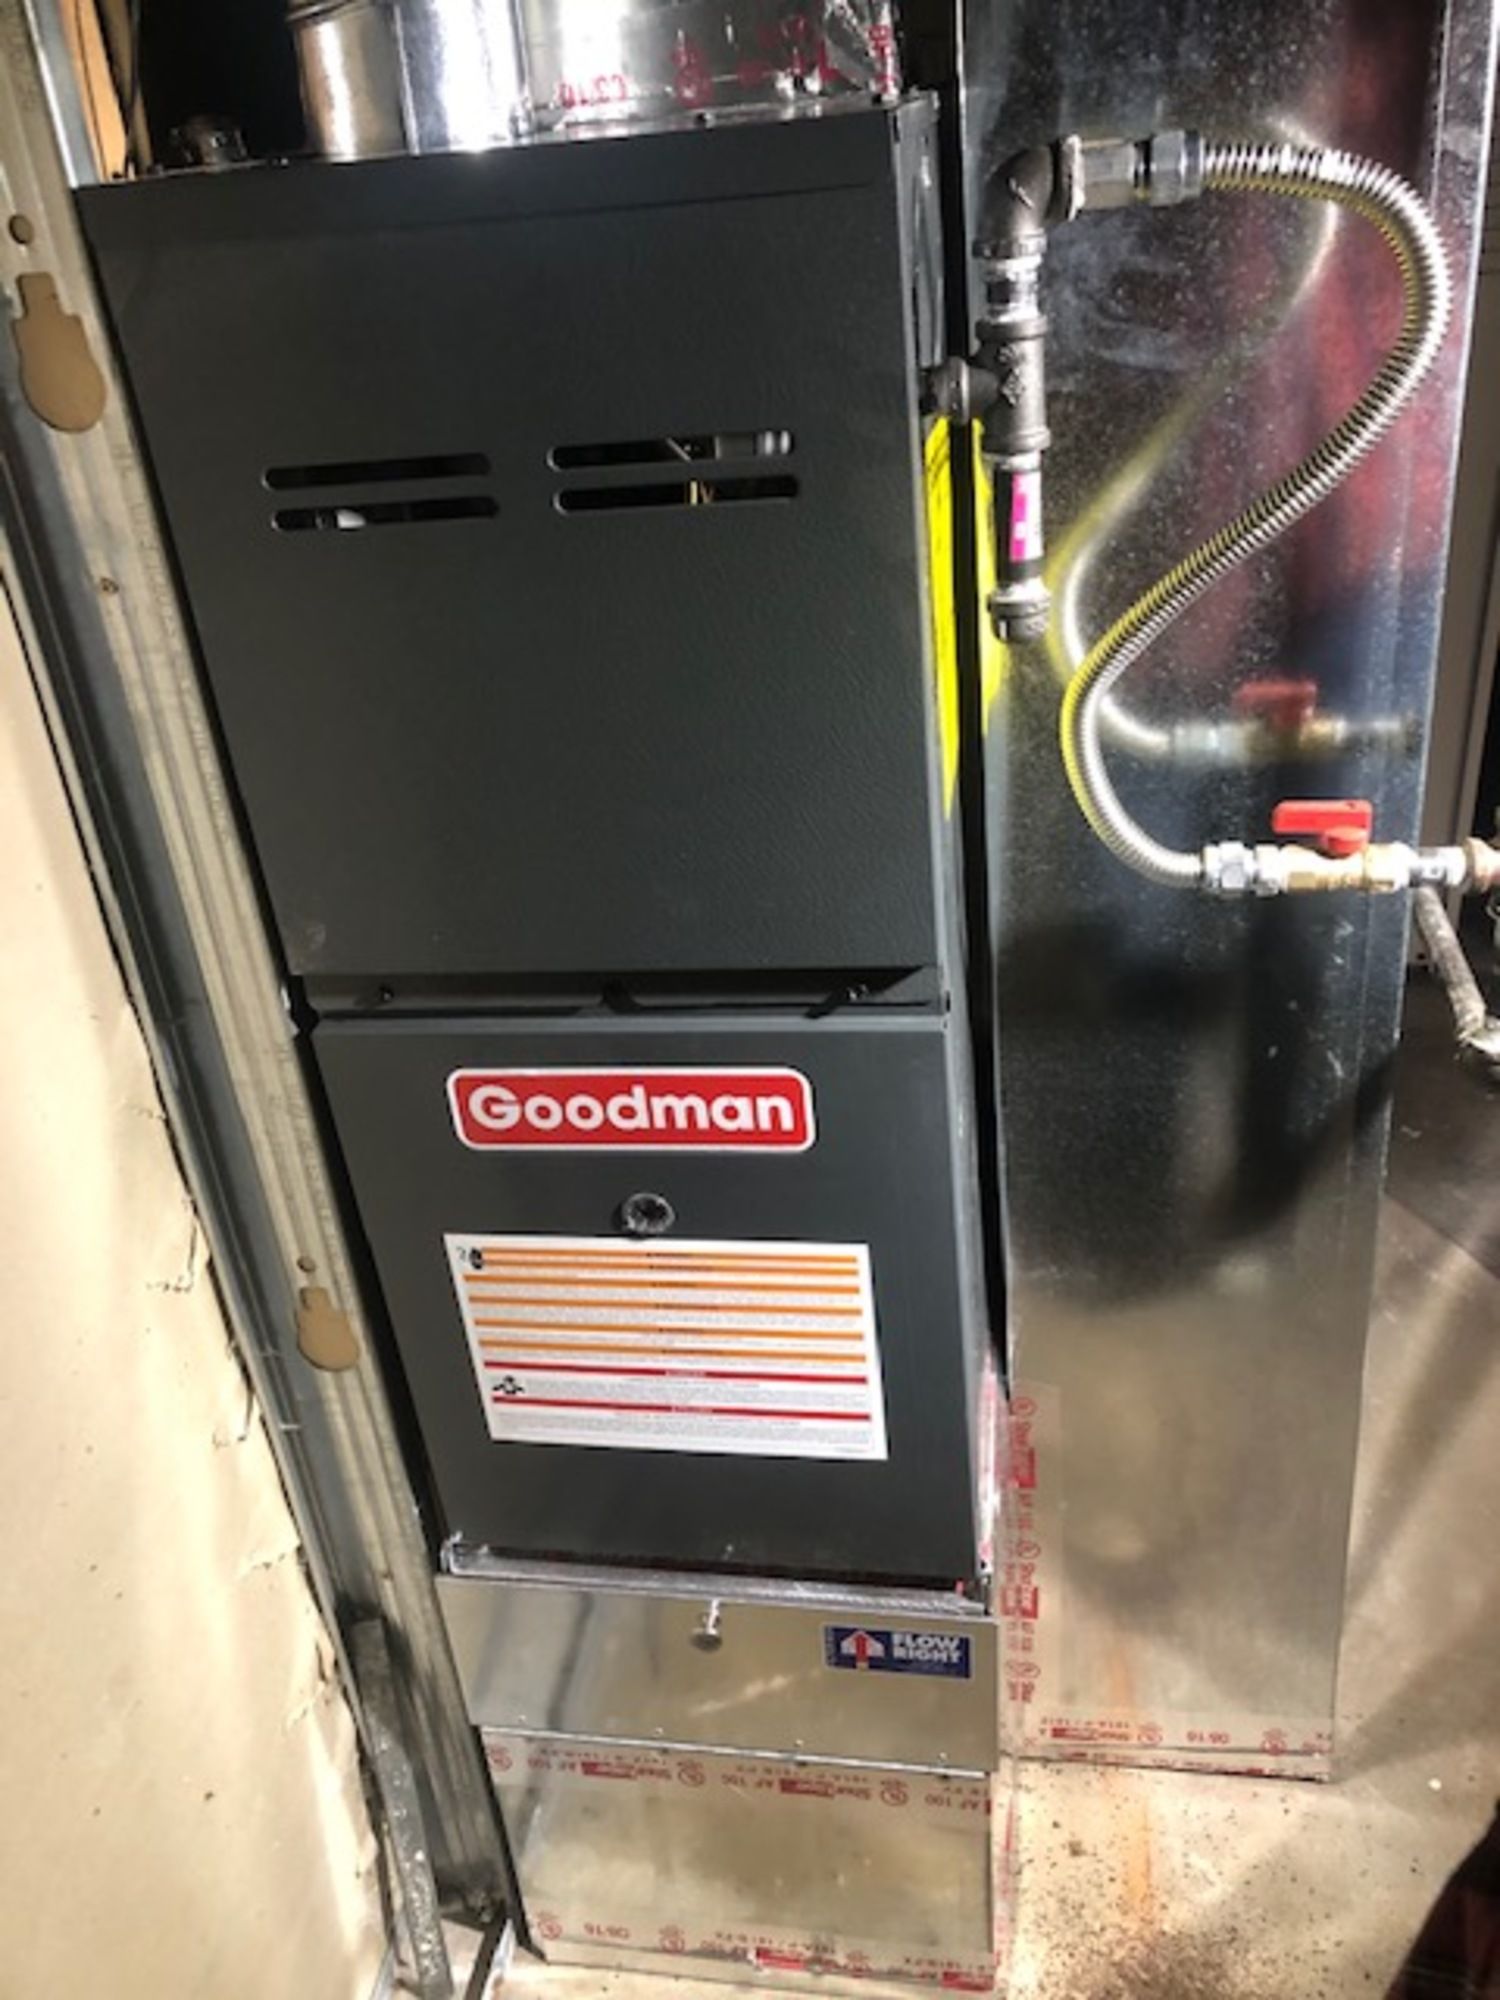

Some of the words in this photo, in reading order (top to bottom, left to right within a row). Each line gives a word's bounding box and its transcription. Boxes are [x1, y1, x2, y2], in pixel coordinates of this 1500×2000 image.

[468, 1084, 795, 1133] Goodman
[892, 1633, 960, 1649] FLOW
[892, 1648, 962, 1663] RIGHT
